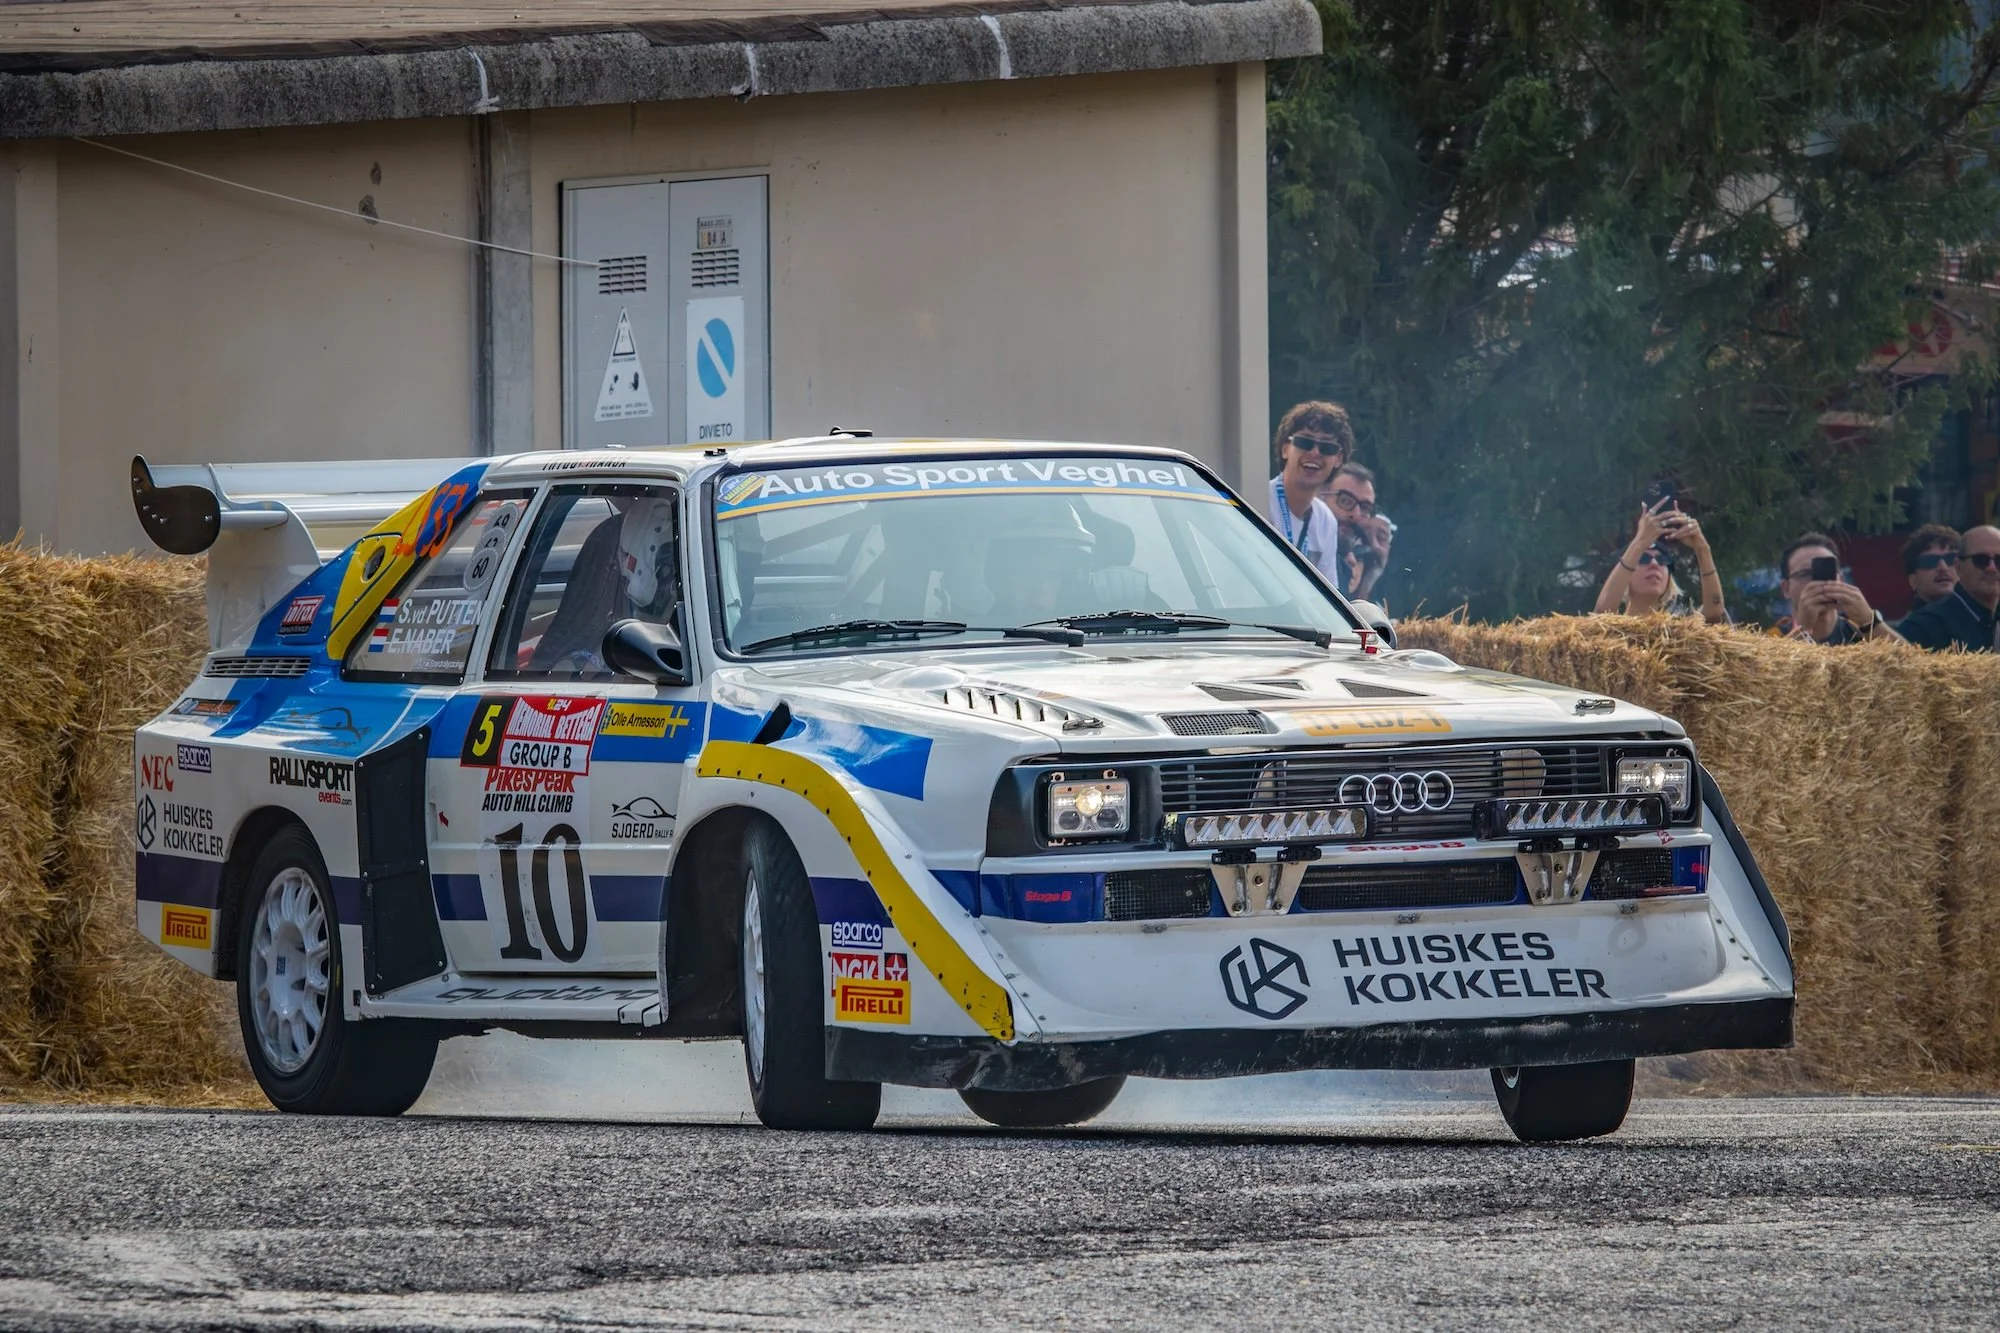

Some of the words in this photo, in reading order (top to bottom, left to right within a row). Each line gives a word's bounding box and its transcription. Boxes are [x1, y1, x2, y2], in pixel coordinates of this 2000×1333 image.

[699, 422, 733, 440] DIVIETO
[759, 470, 874, 499] Auto
[882, 464, 1018, 490] Sport
[1021, 461, 1188, 488] Veghel
[472, 556, 490, 579] 60
[426, 599, 483, 625] PUTTEN
[388, 627, 457, 655] E.NABER
[471, 703, 503, 757] 5
[505, 696, 555, 739] MEMORIAL
[554, 703, 602, 742] BETTEGA
[611, 712, 628, 727] Olle
[177, 747, 212, 771] sparco
[510, 741, 560, 768] GROUP
[563, 745, 572, 769] B
[141, 754, 175, 792] NEC
[269, 756, 353, 792] RALLYSPORT
[163, 802, 213, 830] HUISKES
[481, 793, 512, 813] AUTO
[512, 793, 537, 813] HILL
[537, 794, 574, 813] CLIMB
[163, 827, 224, 858] KOKKELER
[611, 822, 655, 839] SJOERD
[494, 822, 588, 963] 10
[166, 911, 208, 941] PIRELLI
[832, 921, 882, 947] sparco
[1332, 932, 1556, 968] HUISKES
[832, 956, 879, 984] NGK
[436, 985, 660, 1004] quattro
[841, 984, 904, 1016] PIRELLI
[1343, 968, 1612, 1006] KOKKELER
